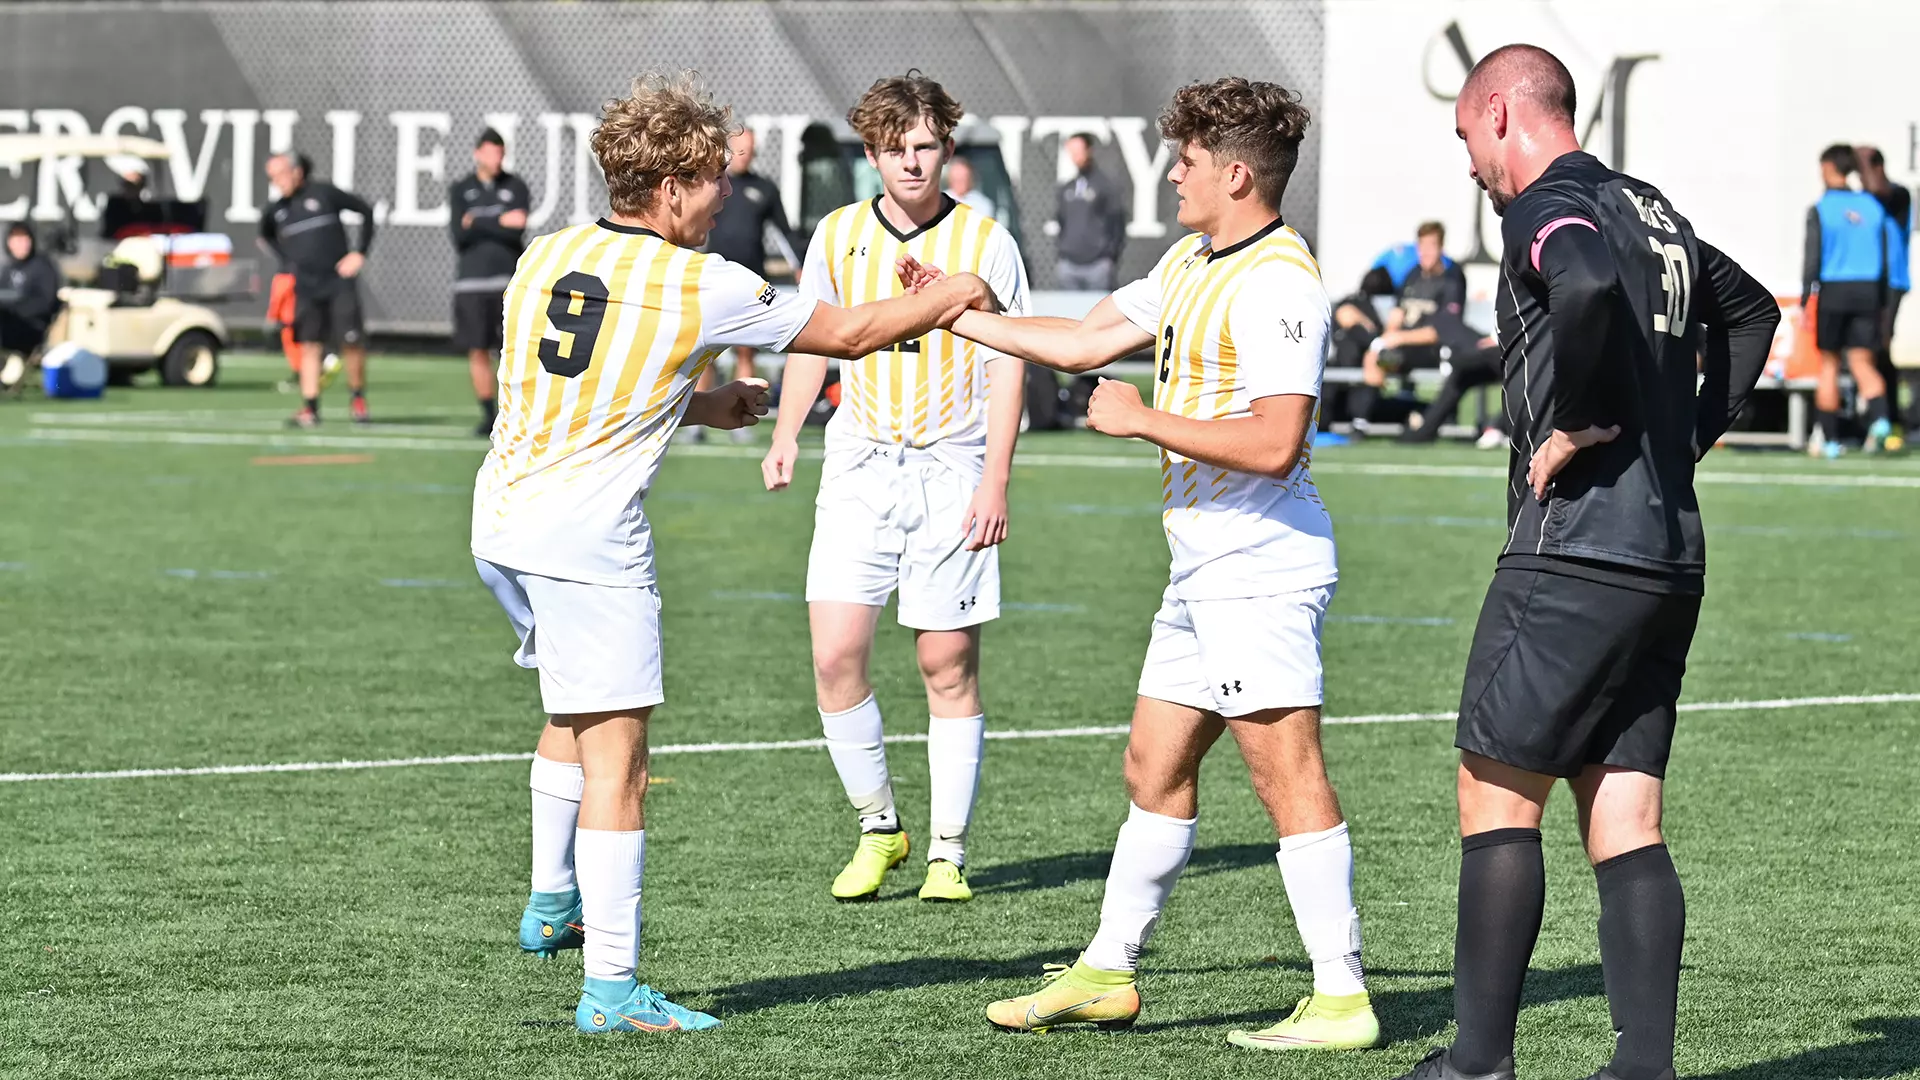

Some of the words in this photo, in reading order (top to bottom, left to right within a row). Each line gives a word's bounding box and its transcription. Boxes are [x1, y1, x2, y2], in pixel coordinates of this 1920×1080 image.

[538, 271, 610, 378] 9
[1648, 236, 1690, 338] 30
[1159, 325, 1174, 383] 2
